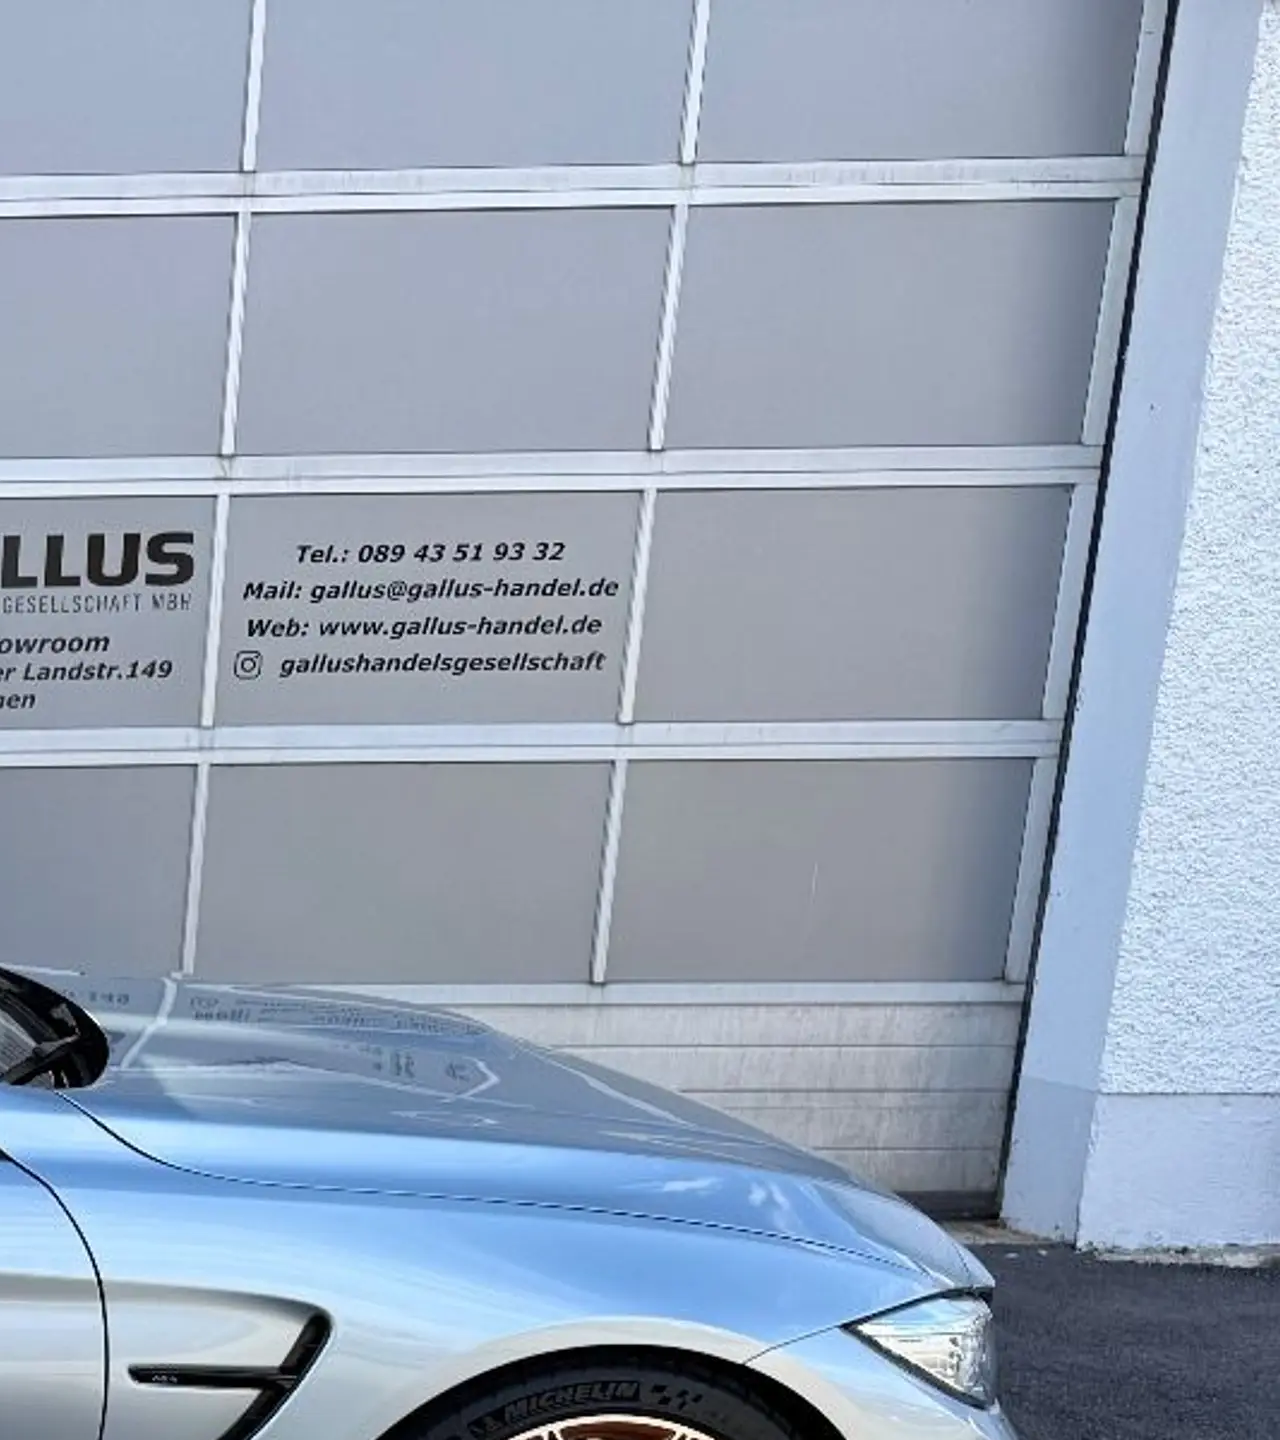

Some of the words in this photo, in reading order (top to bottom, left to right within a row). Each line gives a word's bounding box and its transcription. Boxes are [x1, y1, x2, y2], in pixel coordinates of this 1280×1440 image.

[296, 544, 348, 564] Tel.:
[357, 544, 405, 564] 089
[412, 544, 445, 563] 43
[452, 543, 483, 562] 51
[492, 542, 525, 562] 93
[532, 542, 566, 562] 32
[242, 580, 302, 601] Mail:
[310, 578, 620, 603] gallus@gallus-handel.de
[246, 618, 310, 638] Web:
[319, 615, 603, 640] www.gallus-handel.de
[22, 659, 174, 682] Landstr.149
[279, 651, 606, 678] gallushandelsgesellschaft
[504, 1381, 640, 1421] MICHELIN
